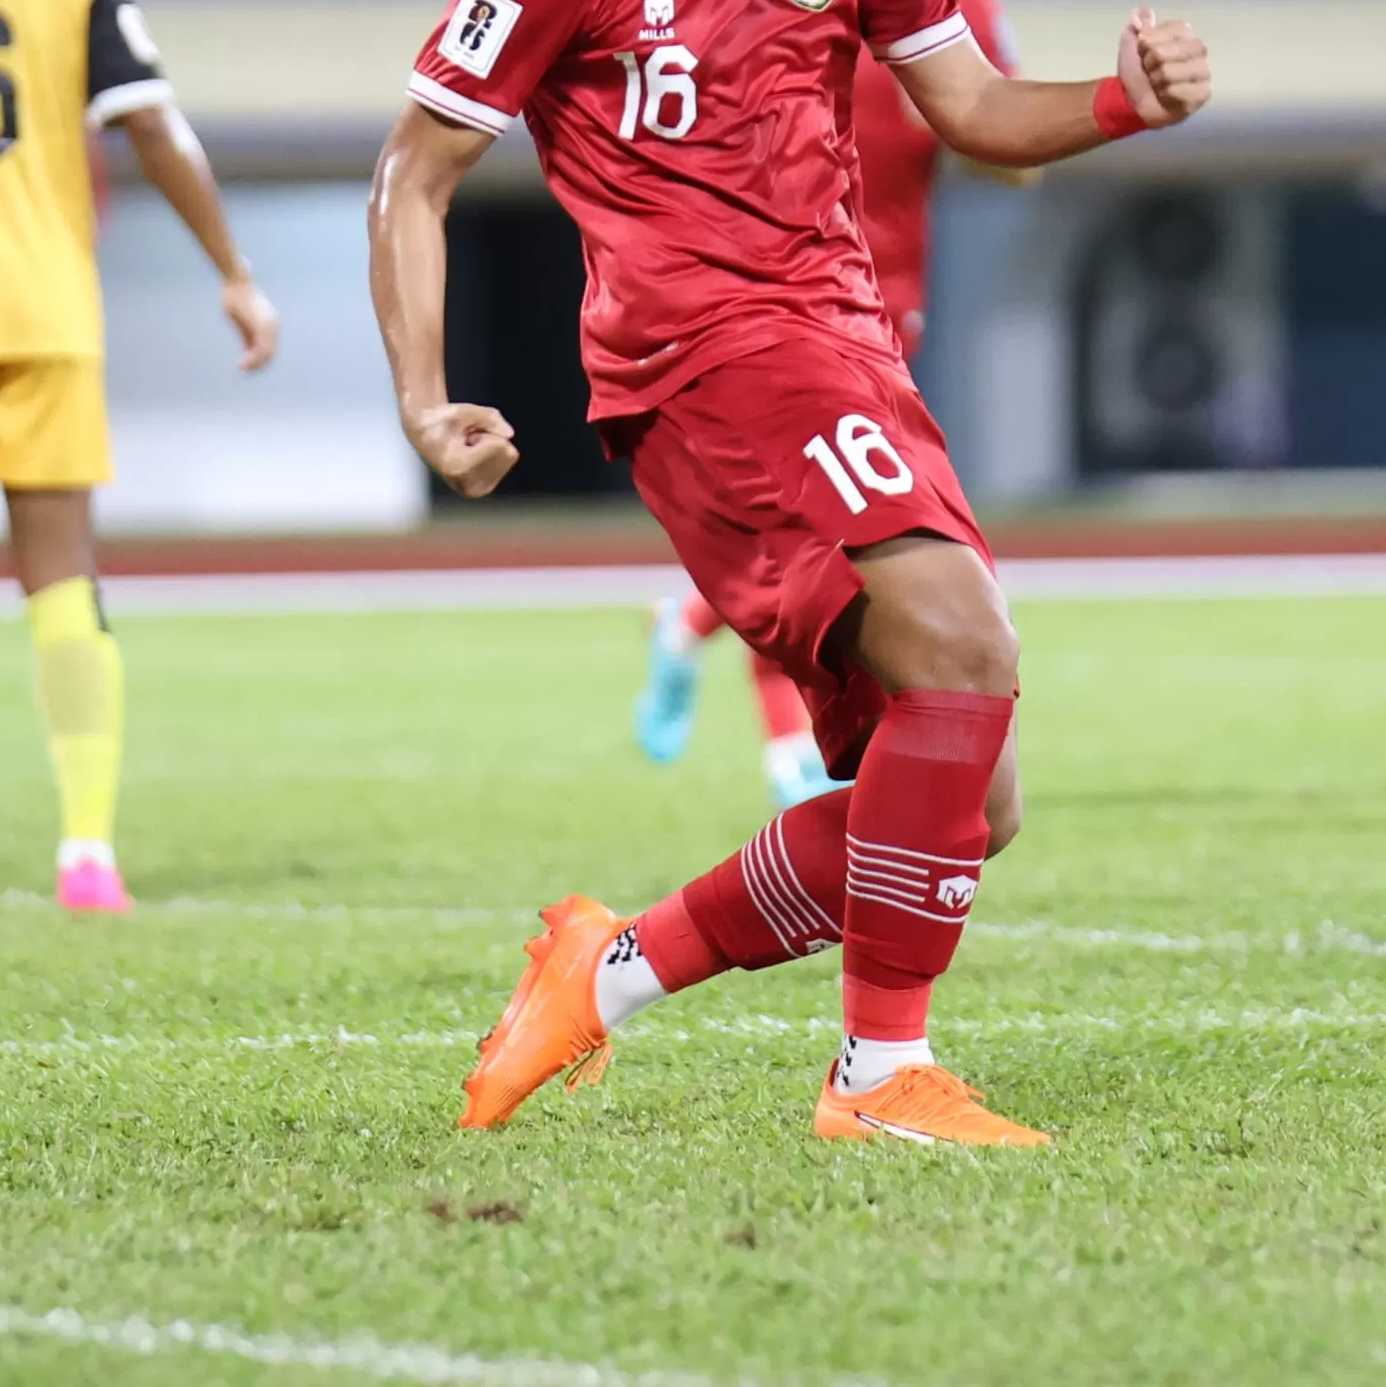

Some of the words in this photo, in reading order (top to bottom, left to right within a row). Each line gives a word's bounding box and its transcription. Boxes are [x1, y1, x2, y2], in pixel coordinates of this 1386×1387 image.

[638, 27, 676, 41] MILLS
[612, 45, 699, 141] 16
[802, 413, 914, 515] 16
